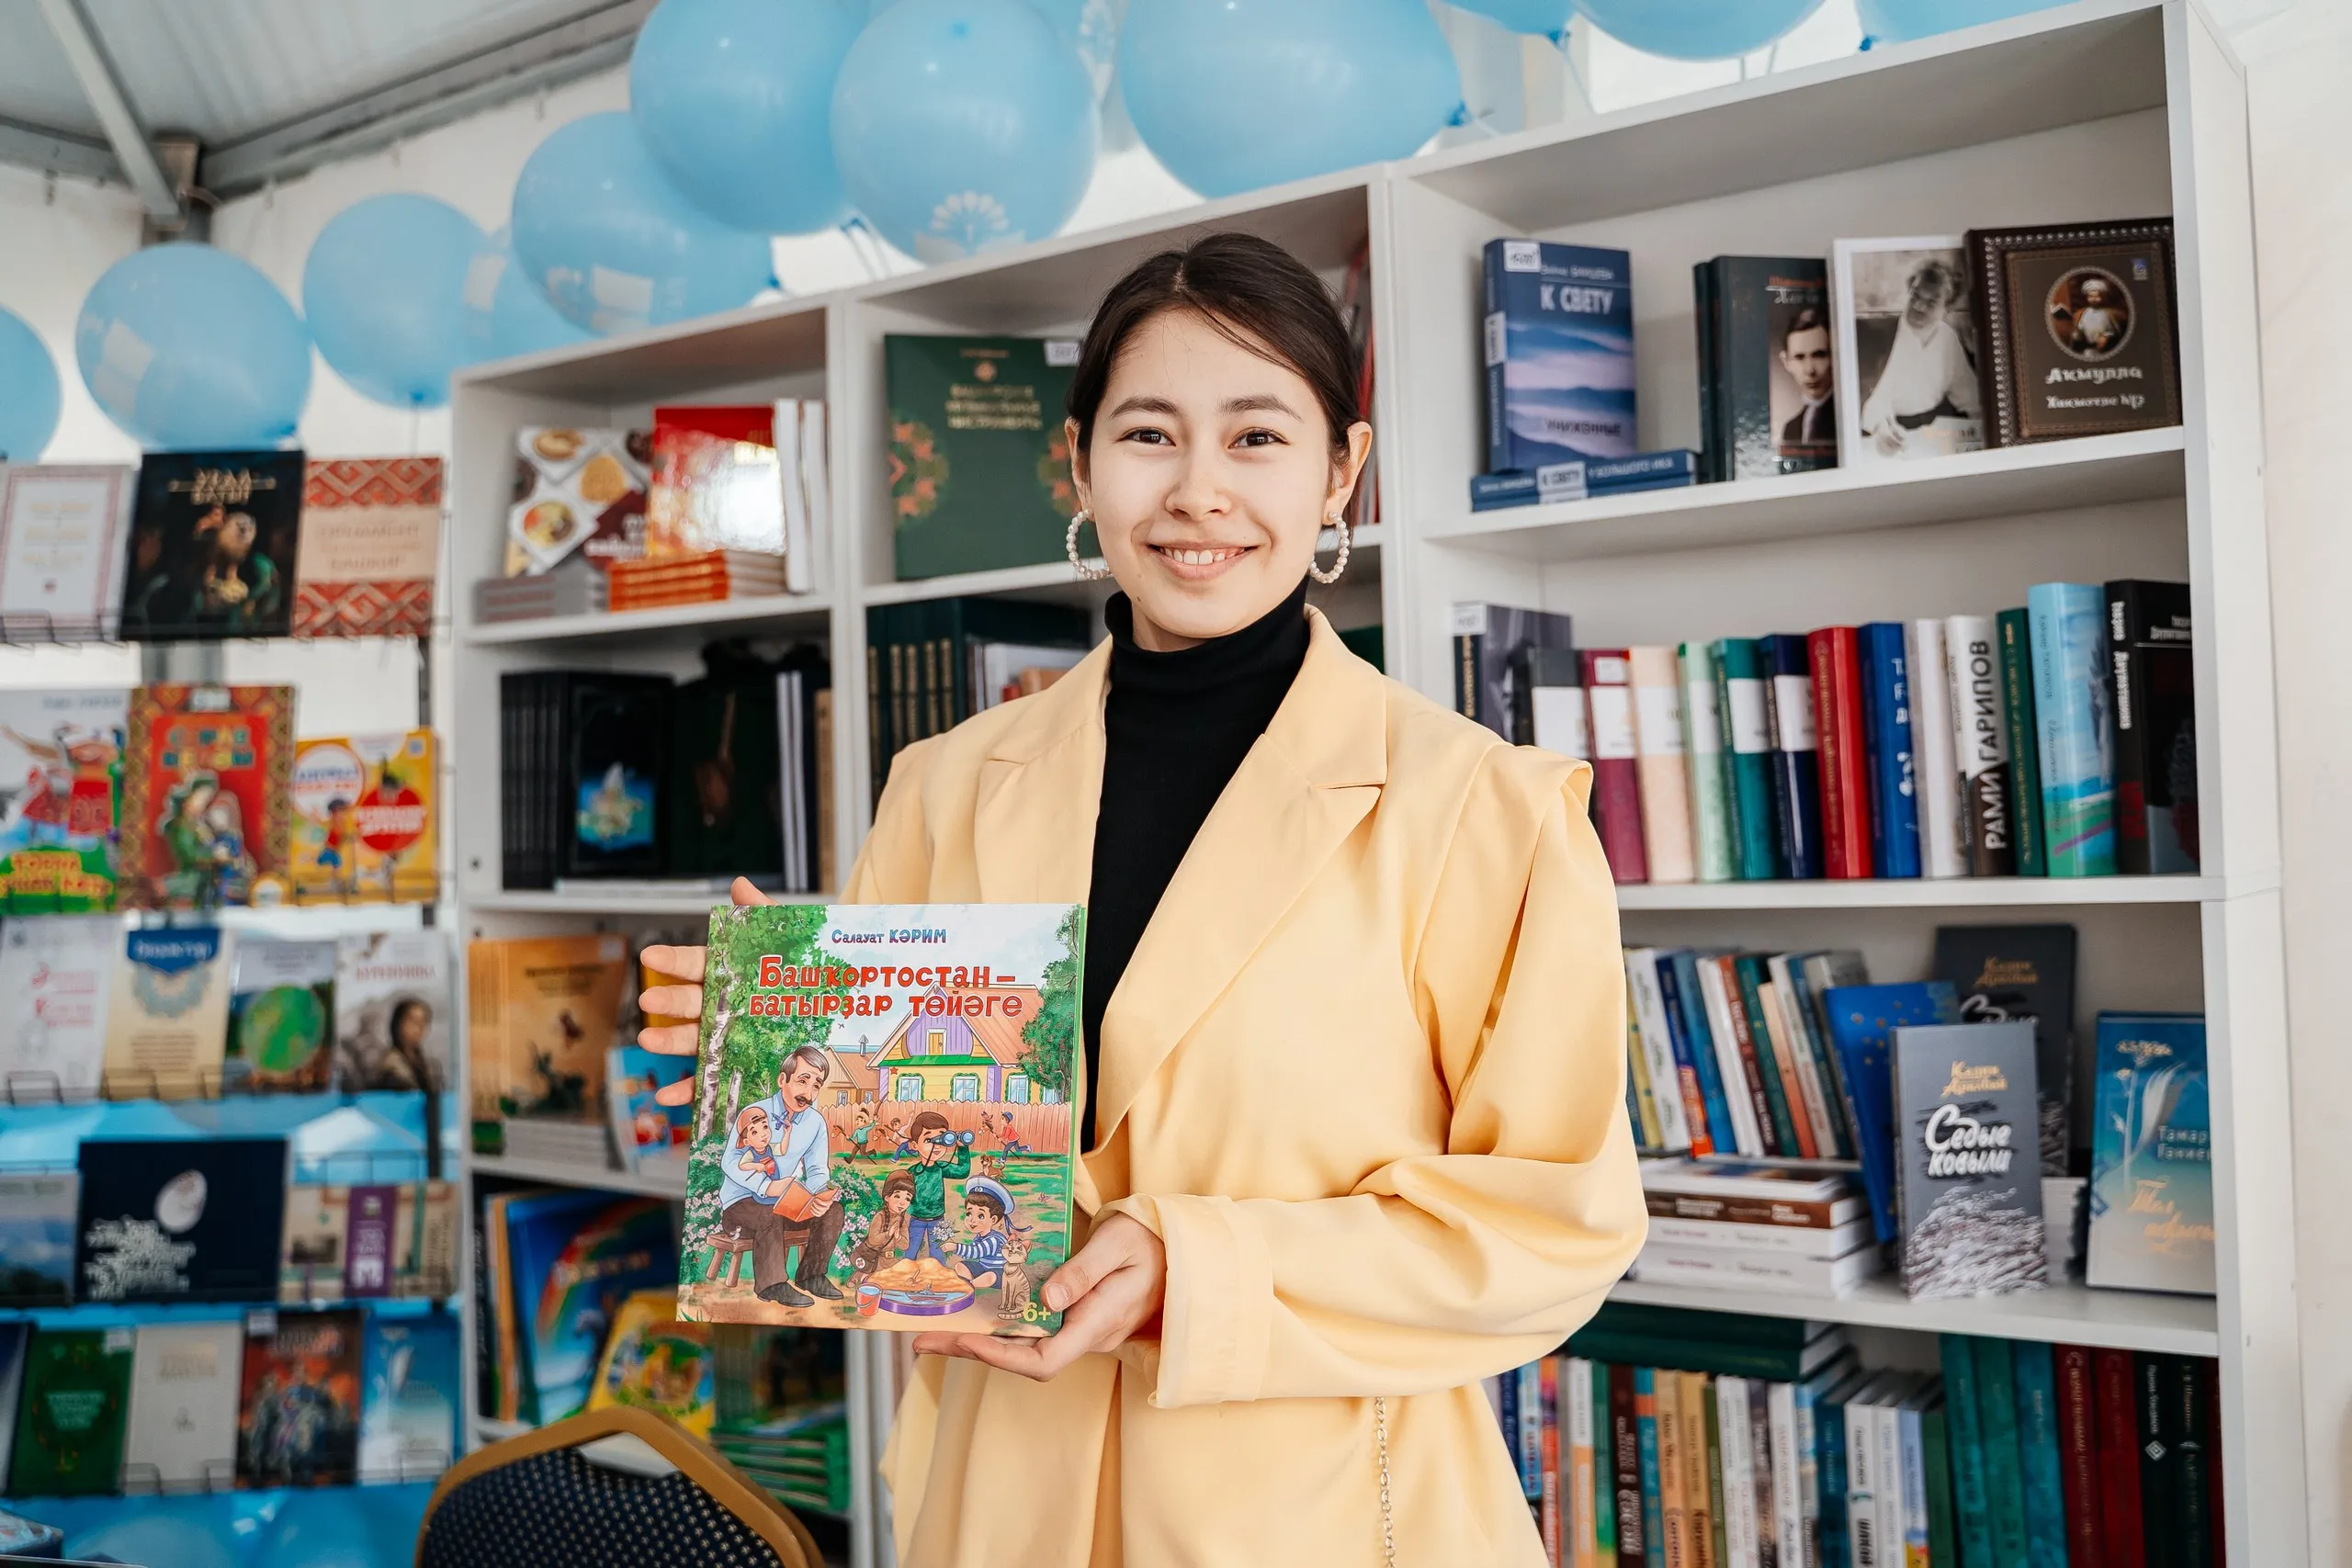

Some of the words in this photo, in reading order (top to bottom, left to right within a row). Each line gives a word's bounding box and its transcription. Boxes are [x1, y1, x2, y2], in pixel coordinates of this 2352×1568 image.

[1540, 284, 1555, 310] К
[1559, 286, 1613, 315] СВЕТУ
[1969, 639, 2000, 763] ГАРИПОВ
[1979, 772, 2007, 850] РАМИ
[831, 929, 885, 944] Салауат
[889, 929, 947, 943] КӘРИМ
[908, 990, 1023, 1018] төйәге
[1925, 1103, 2013, 1153] Седые
[2159, 1126, 2209, 1147] Тамар
[1928, 1149, 2013, 1178] ковыли
[1023, 1301, 1051, 1322] 6+
